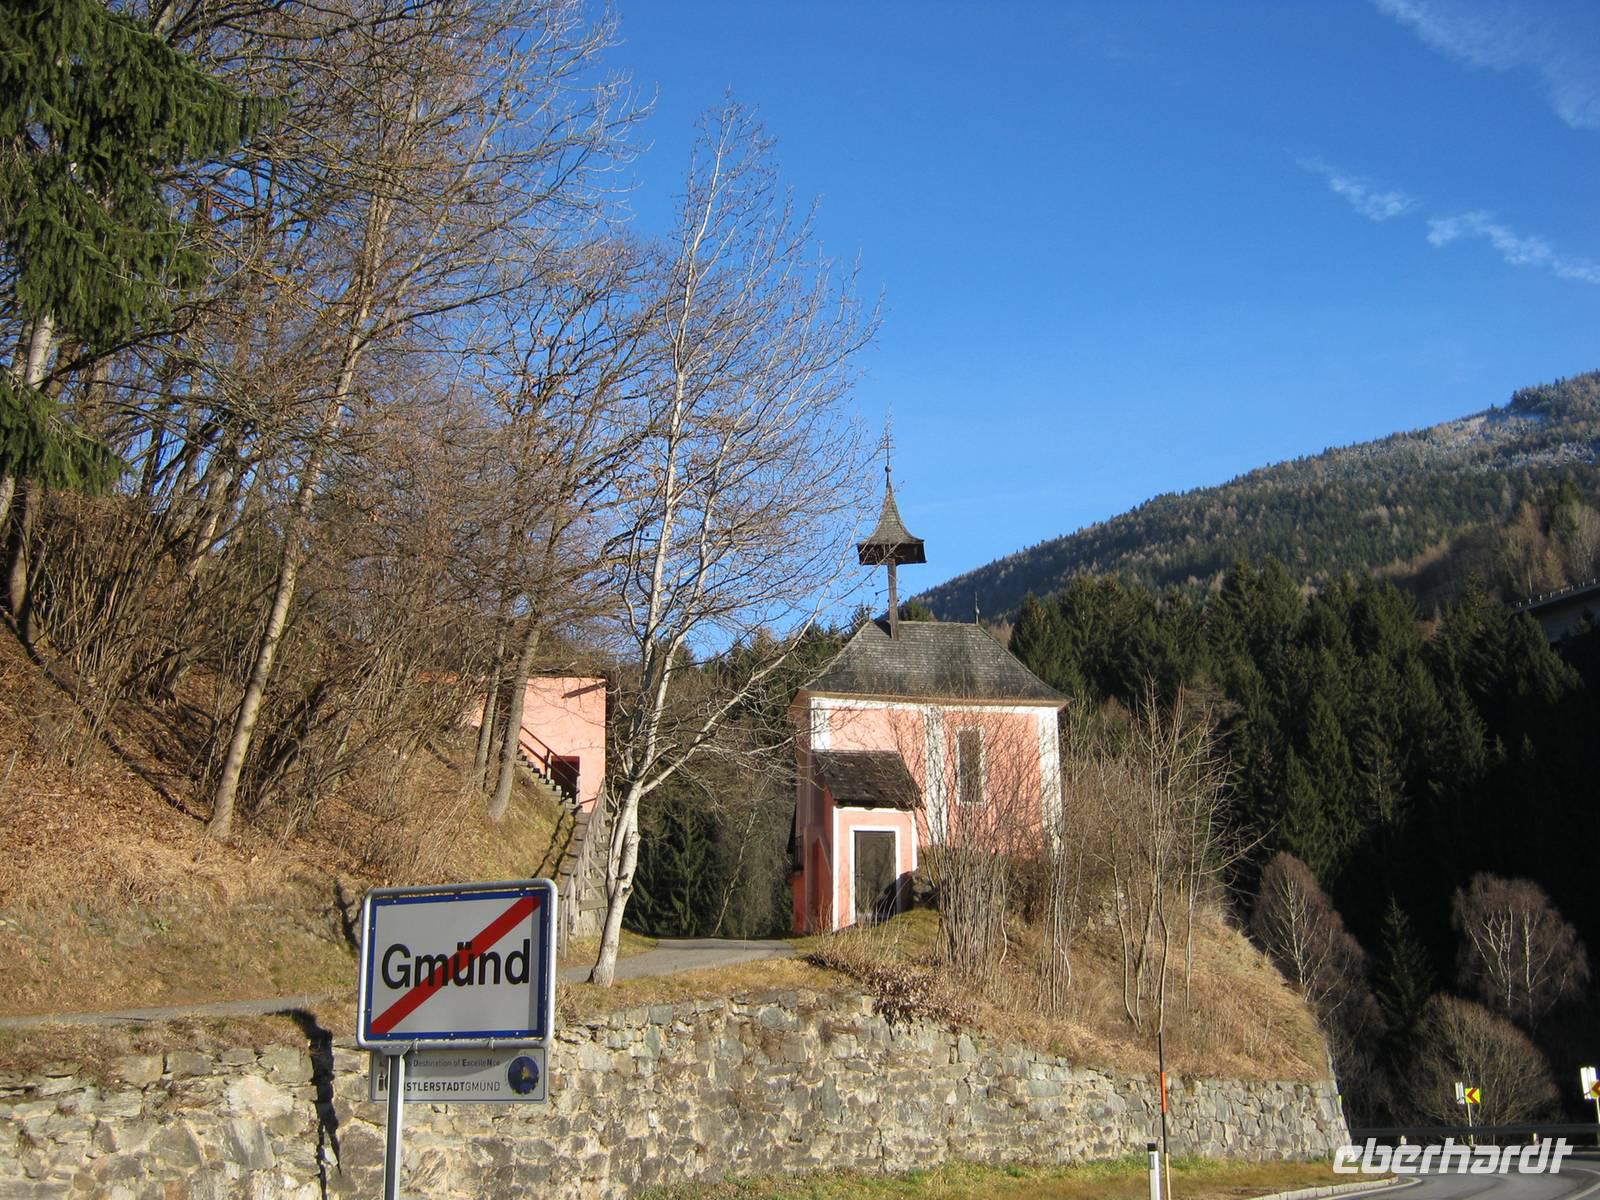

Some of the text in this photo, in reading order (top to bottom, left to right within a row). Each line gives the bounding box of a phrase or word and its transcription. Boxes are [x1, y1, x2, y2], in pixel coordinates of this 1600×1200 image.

[382, 939, 531, 989] Gmünd
[413, 1058, 452, 1067] Destination
[453, 1058, 461, 1067] of
[404, 1080, 501, 1092] STLERSTADTGMÜND
